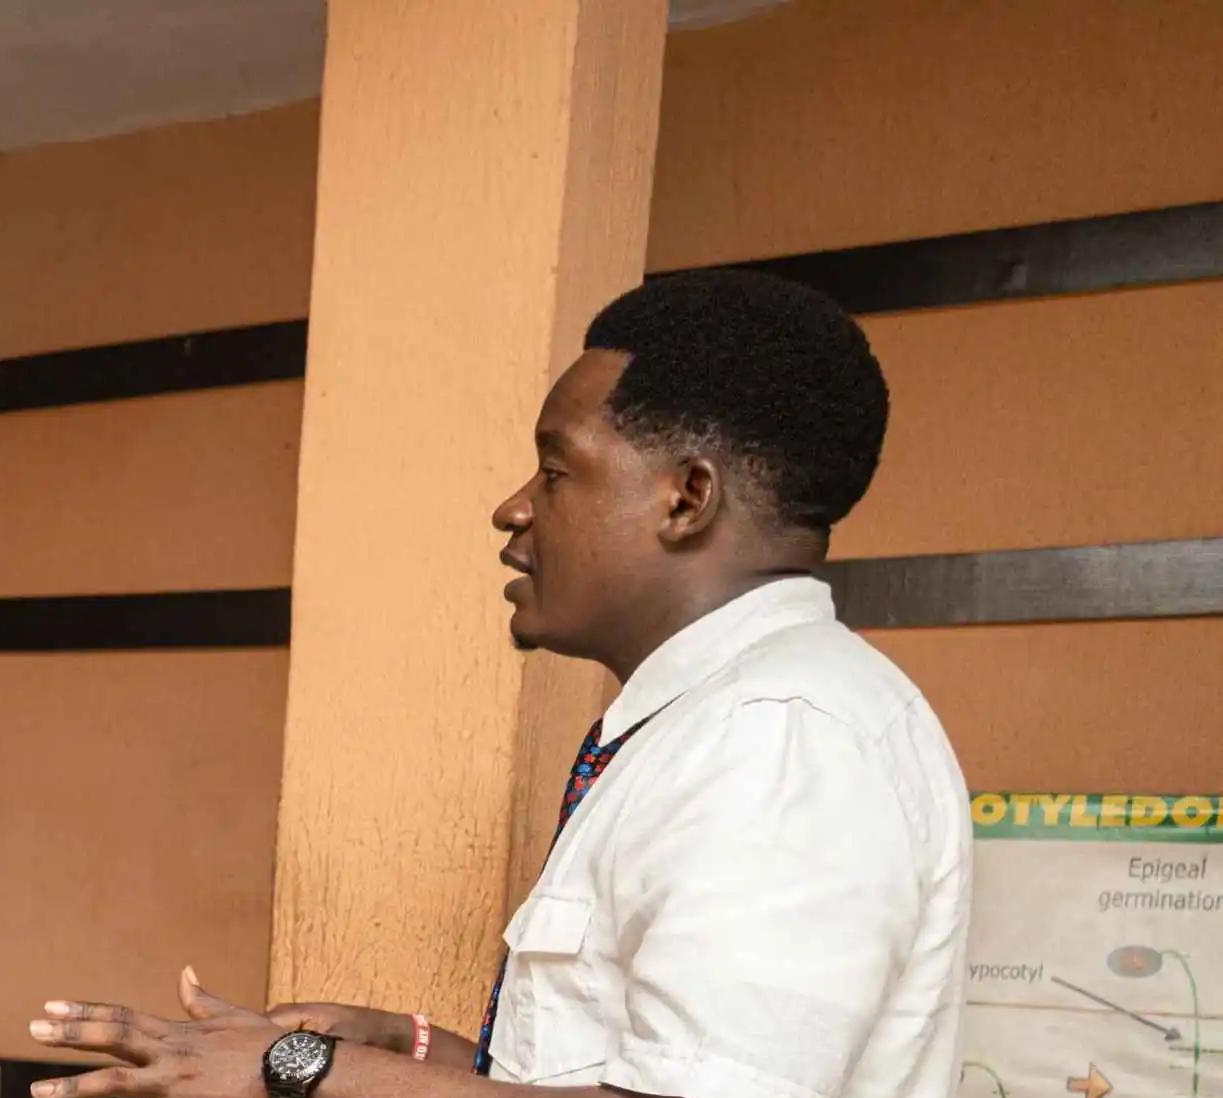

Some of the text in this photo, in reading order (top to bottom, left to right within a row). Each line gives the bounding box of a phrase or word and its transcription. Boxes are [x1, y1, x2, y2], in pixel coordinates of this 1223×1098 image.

[971, 793, 1223, 830] OTYLEDO
[1128, 855, 1208, 884] Epigeal
[969, 960, 1044, 984] ypocotyl
